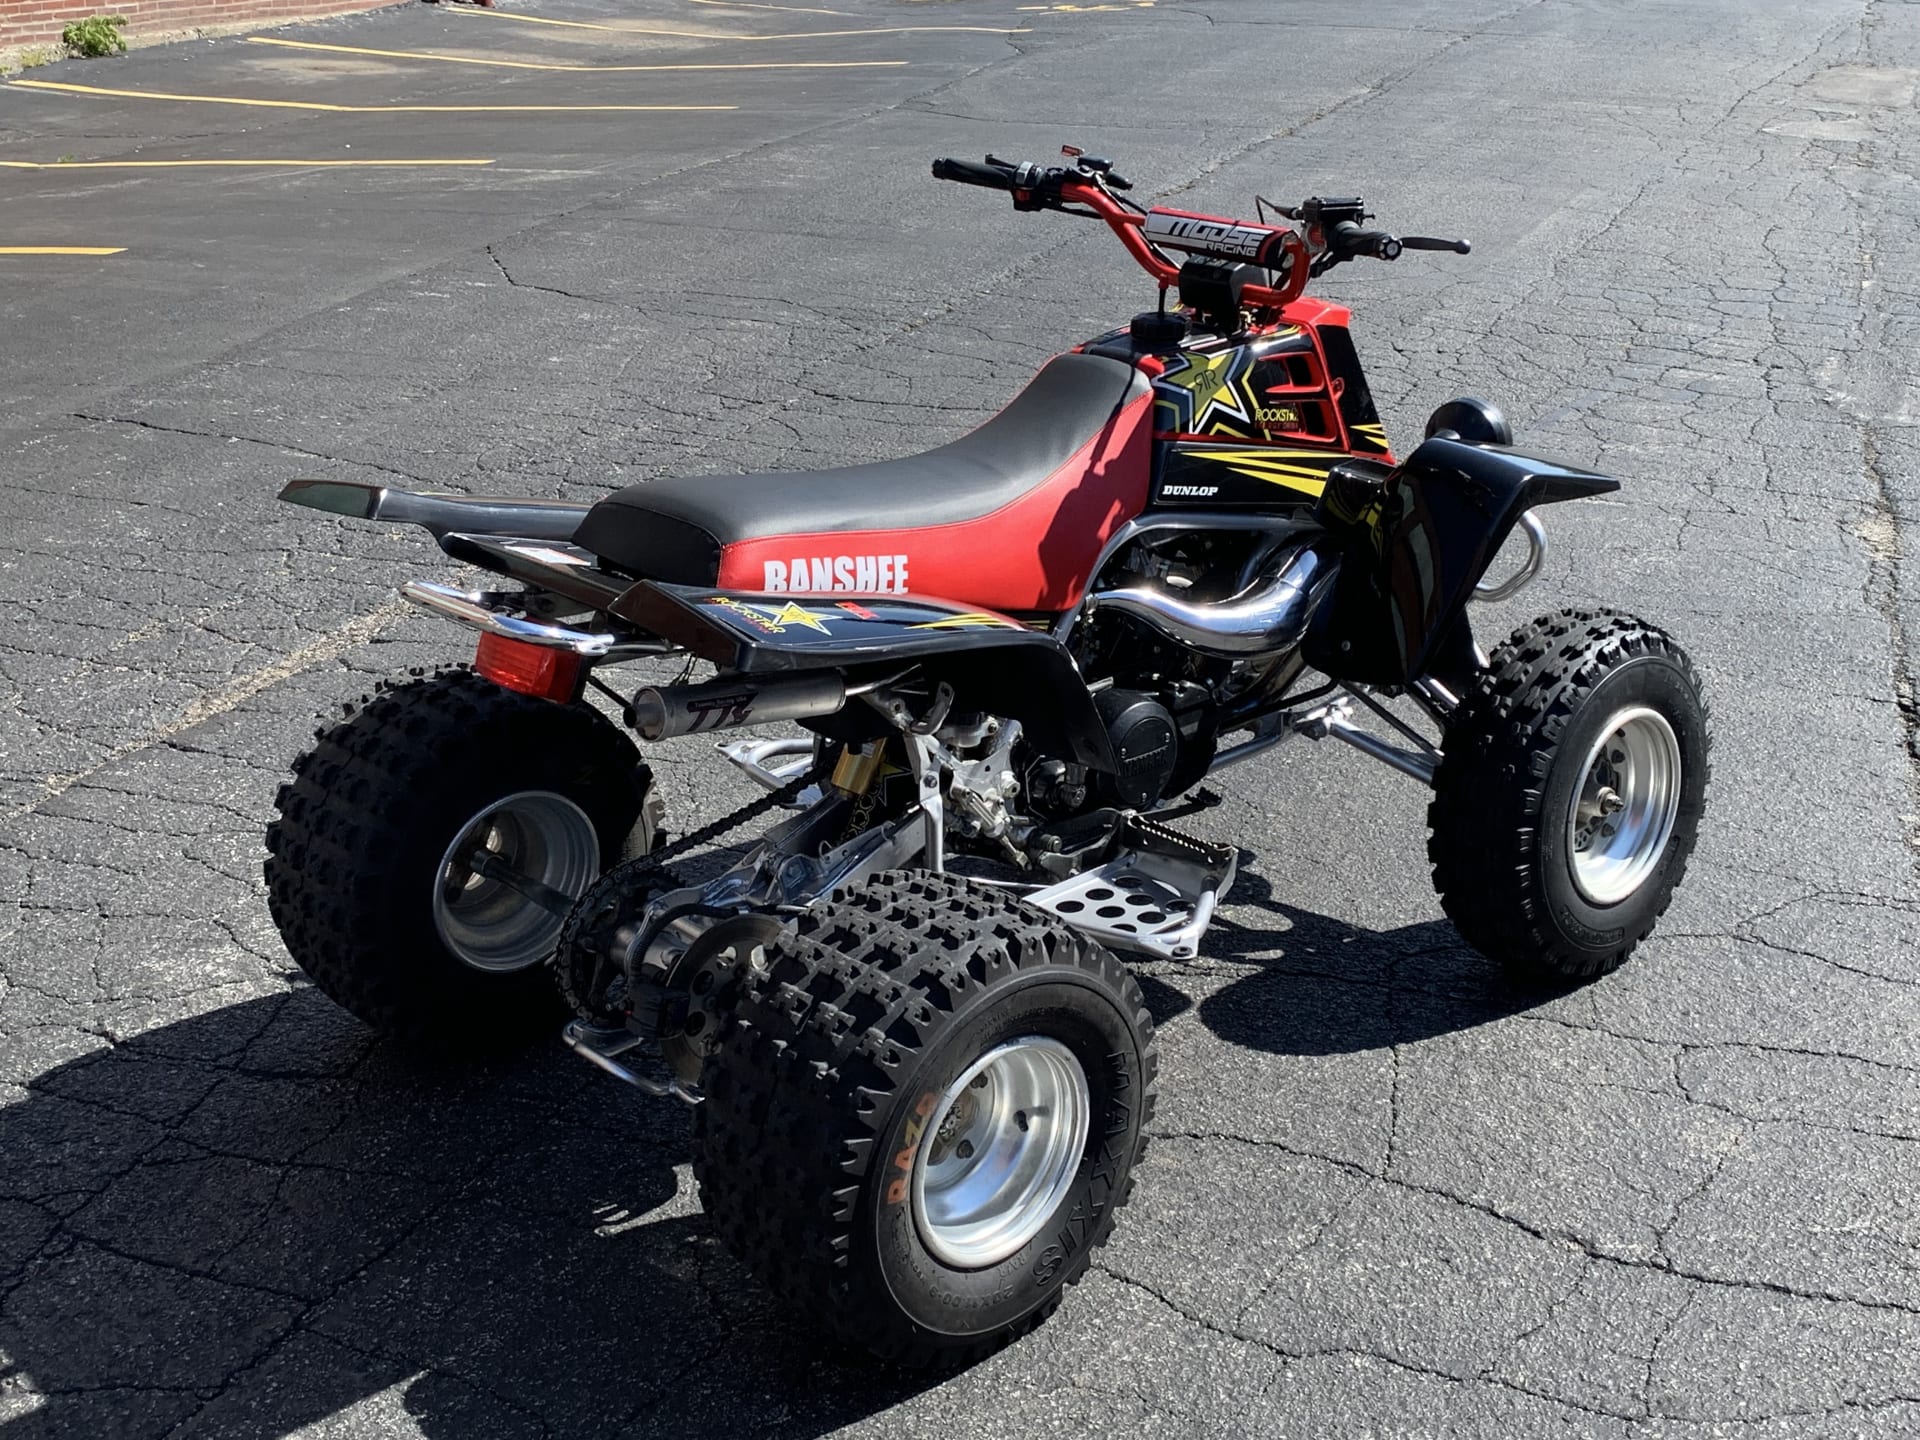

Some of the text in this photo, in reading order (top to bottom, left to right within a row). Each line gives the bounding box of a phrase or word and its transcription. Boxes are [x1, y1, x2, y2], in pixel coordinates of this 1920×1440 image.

[1169, 218, 1271, 247] MOOSE
[1205, 242, 1257, 257] RACING
[1162, 485, 1219, 497] DUNLOP
[763, 554, 909, 593] BANSHEE
